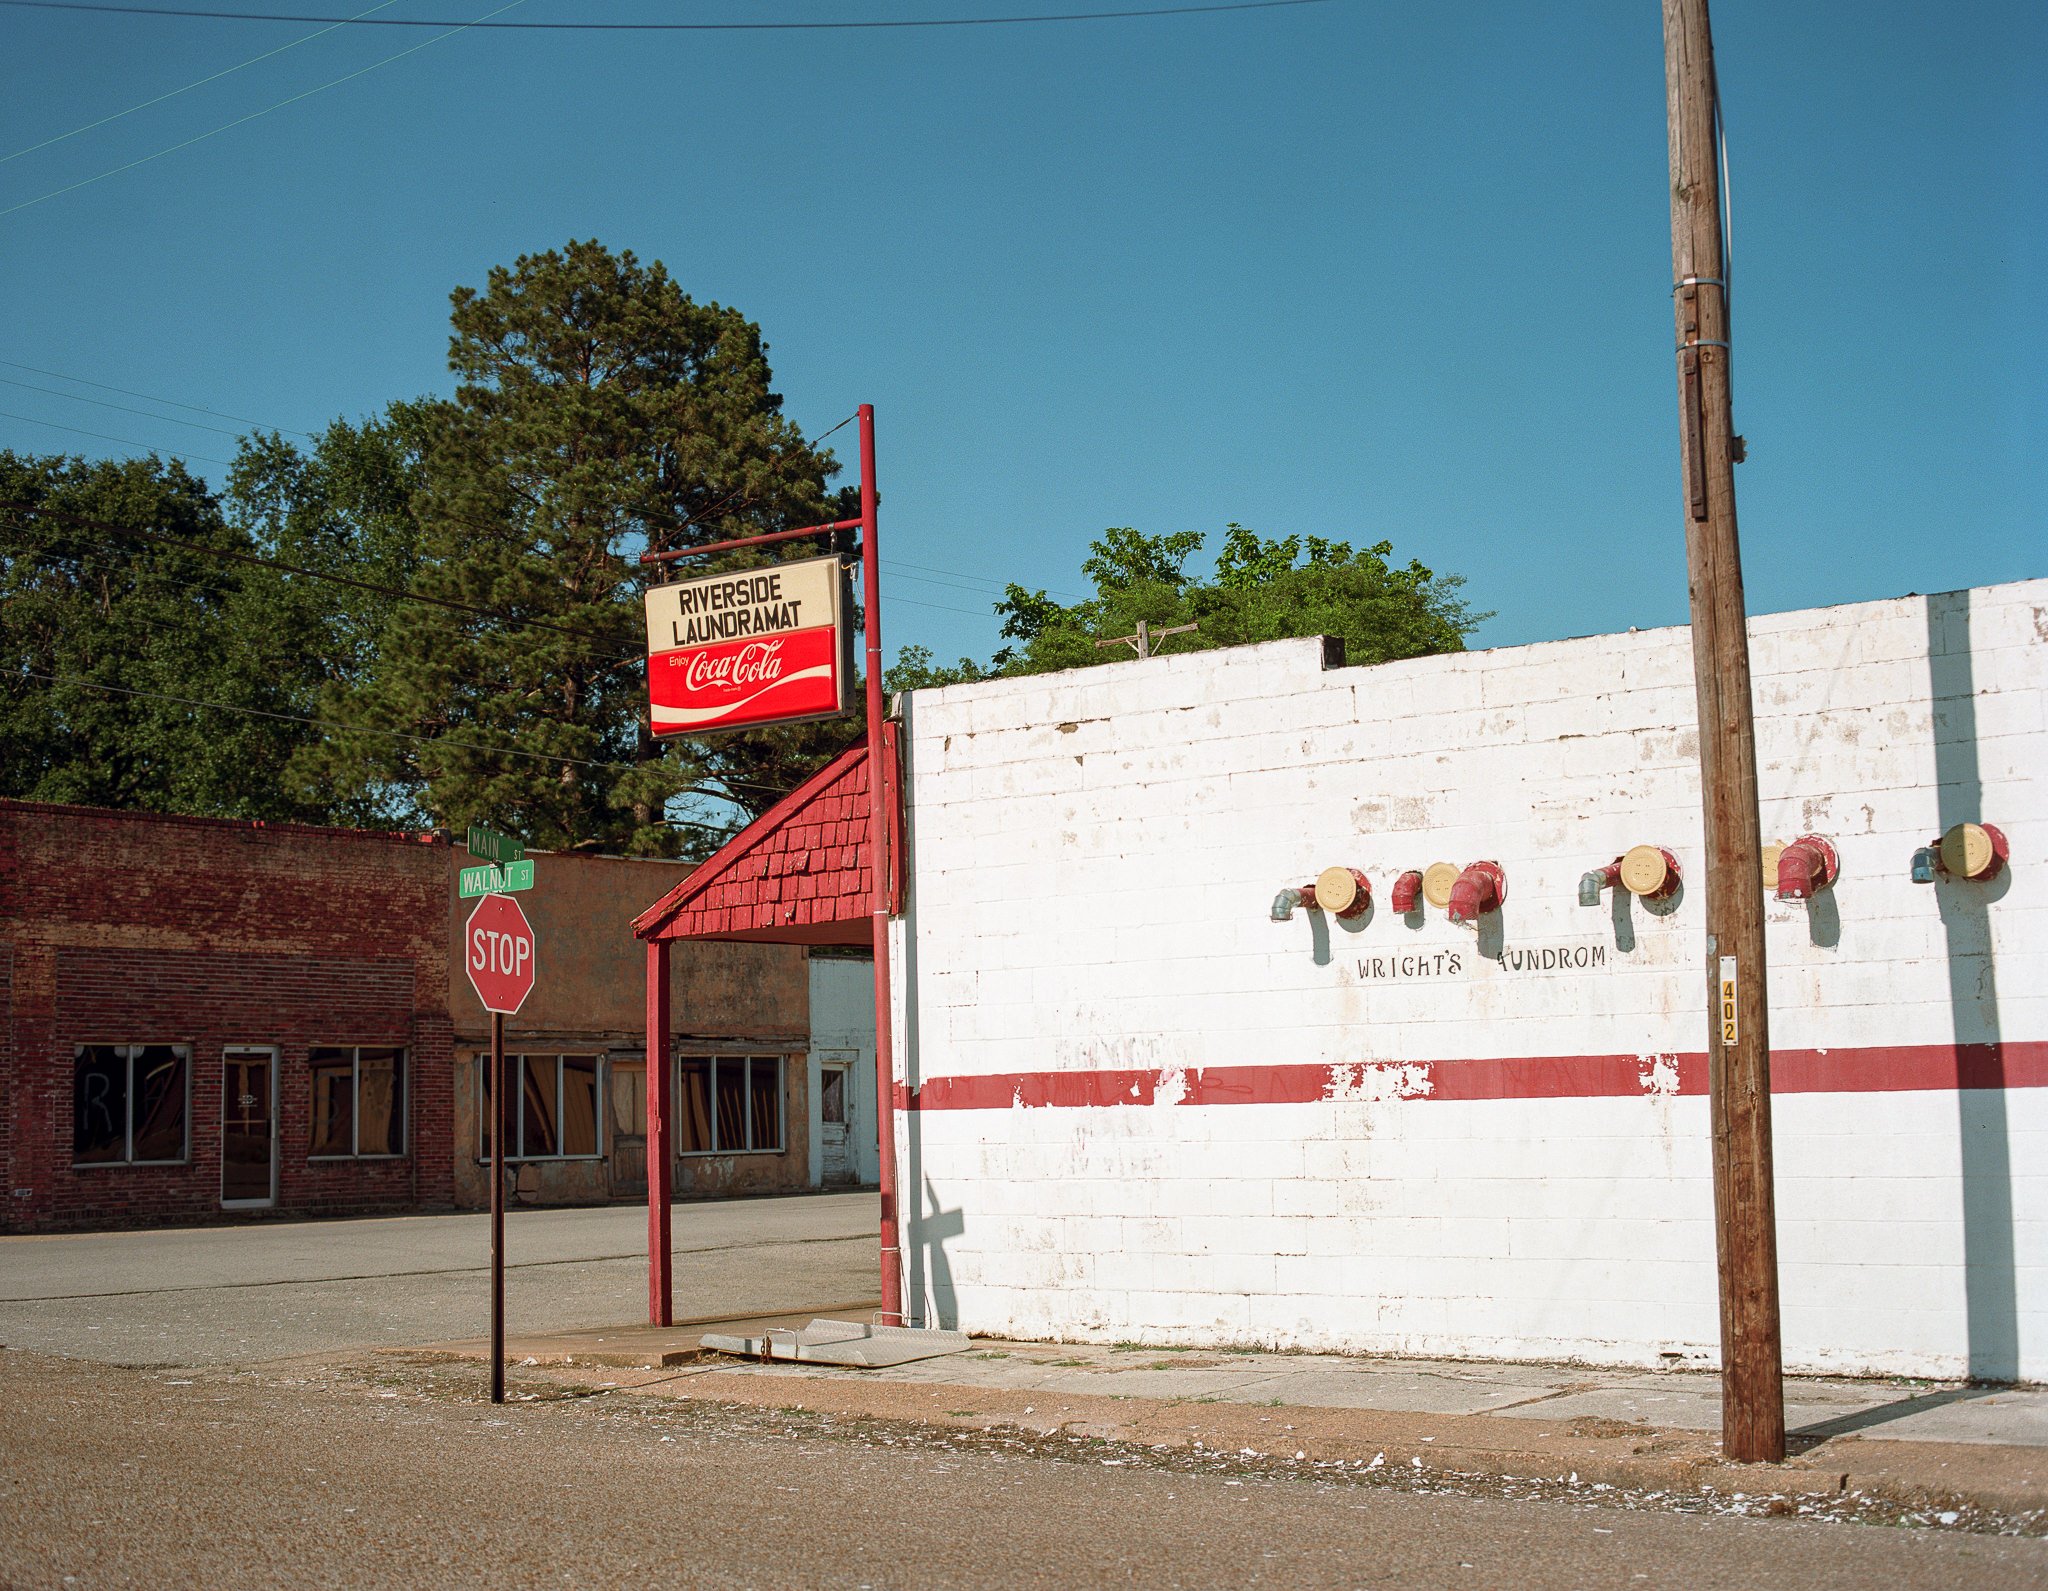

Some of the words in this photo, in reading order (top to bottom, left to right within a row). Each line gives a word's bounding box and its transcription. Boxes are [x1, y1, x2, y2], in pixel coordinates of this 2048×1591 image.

[679, 574, 782, 615] RIVERSIDE
[672, 600, 802, 646] LAUNDRAMAT
[669, 655, 690, 668] Enjoy
[686, 638, 786, 692] Coca-Cola
[472, 831, 499, 859] MAIN
[513, 849, 522, 861] ST
[463, 866, 514, 894] WALNUT
[520, 869, 529, 881] ST
[472, 928, 530, 977] STOP
[1357, 949, 1462, 979] WRIGHT'S
[1724, 982, 1735, 1041] 402
